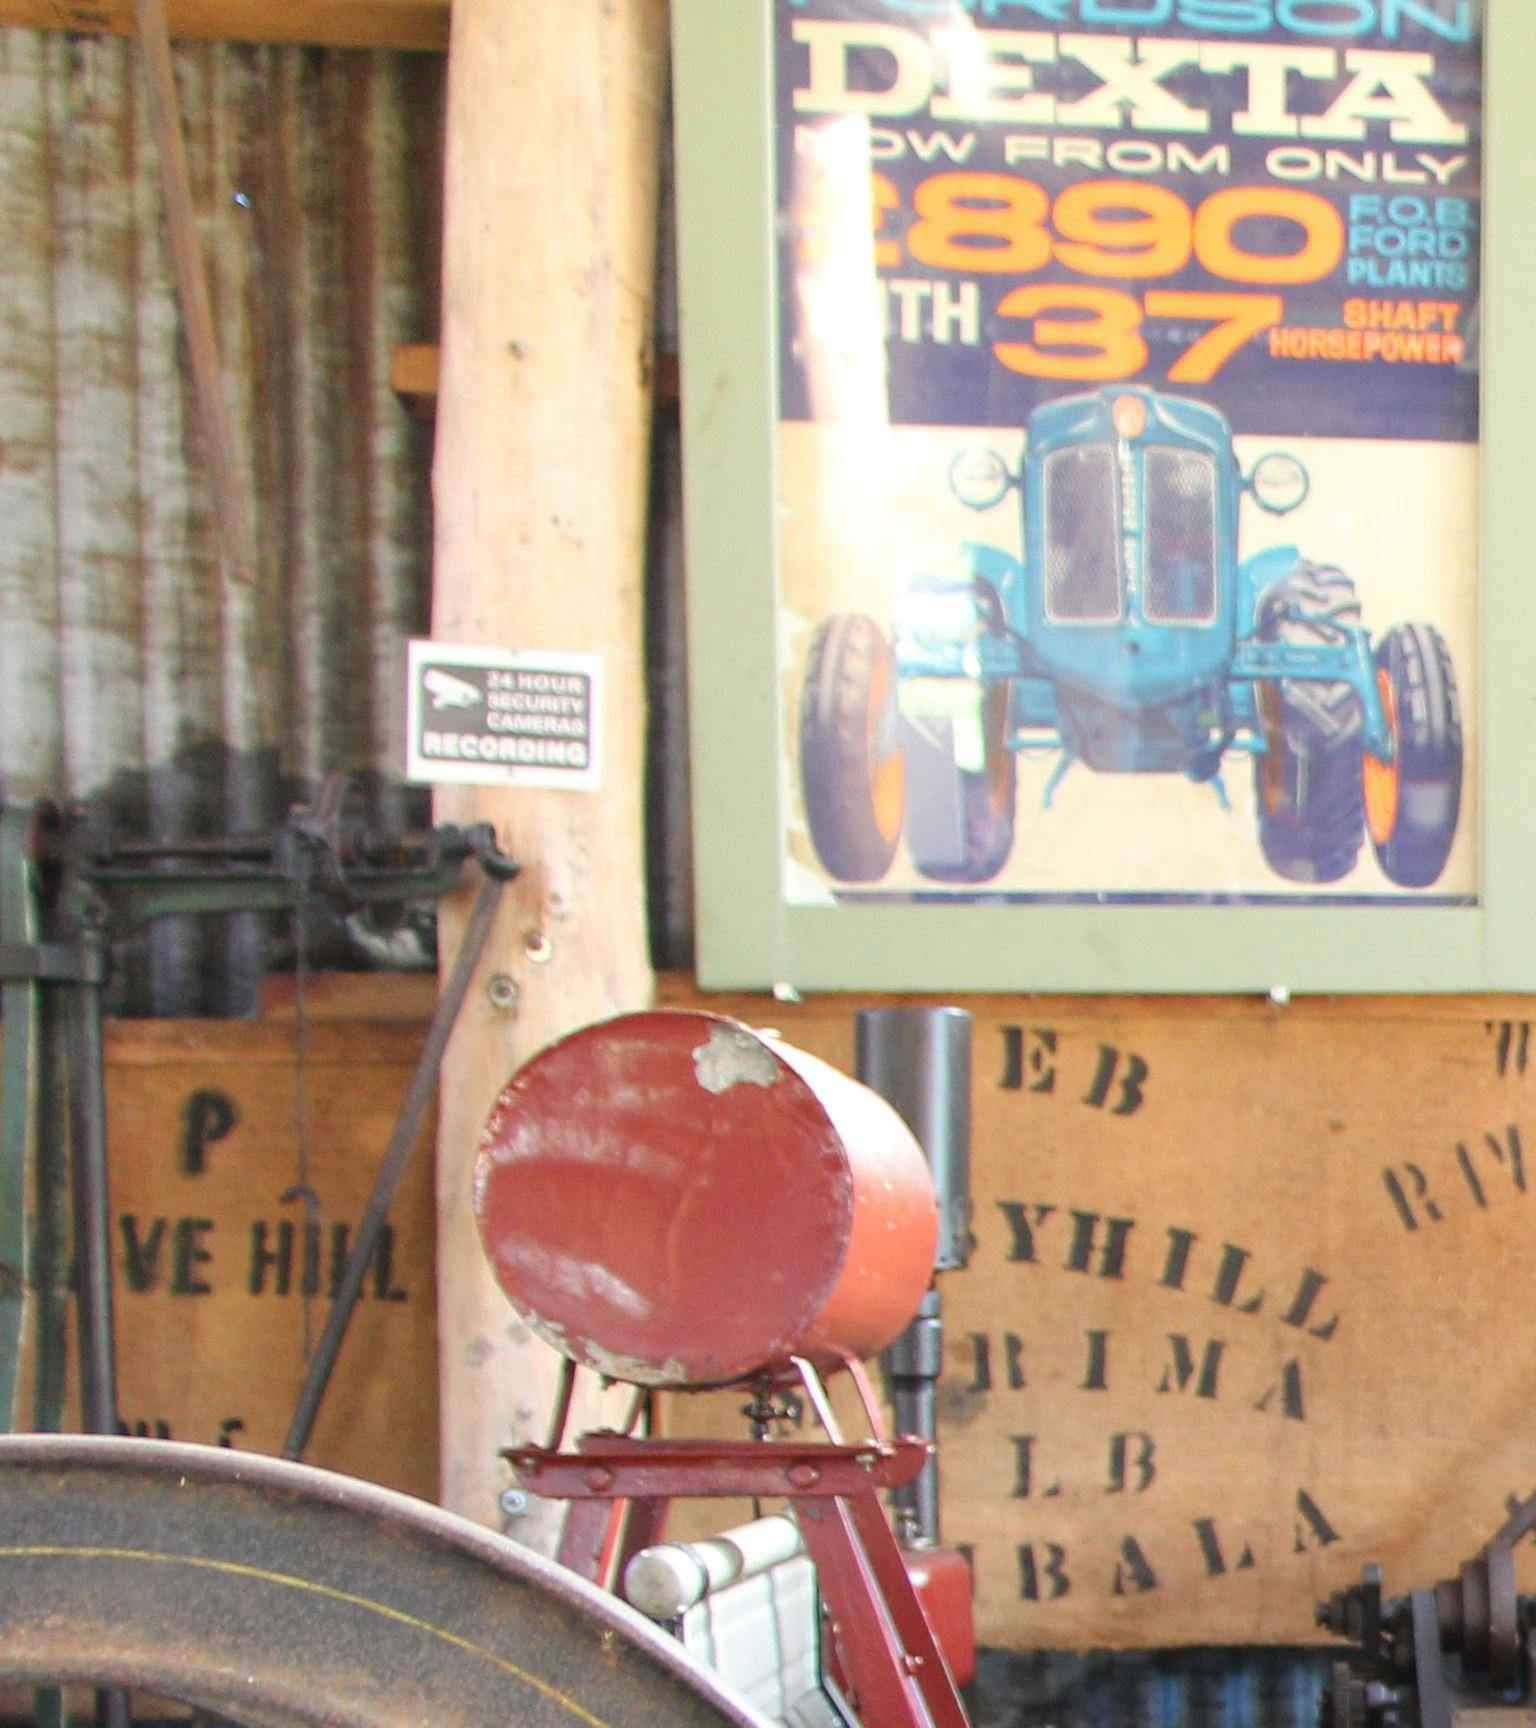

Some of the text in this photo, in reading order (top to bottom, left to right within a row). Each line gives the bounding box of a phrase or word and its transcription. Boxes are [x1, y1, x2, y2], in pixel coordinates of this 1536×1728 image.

[792, 19, 1468, 144] DEXTA
[795, 125, 1469, 185] OW FROM ONLY
[1349, 224, 1470, 260] FORD
[1347, 256, 1467, 289] PLANTS
[992, 283, 1284, 382] 37
[1343, 297, 1462, 333] SHAFT
[1267, 326, 1466, 364] HORSEPOWER
[486, 669, 584, 696] 24 HOUR
[486, 690, 584, 716] SECURITY
[486, 710, 588, 738] CAMERAS
[422, 731, 588, 768] RECORDING
[180, 1089, 237, 1177] P
[956, 1485, 1342, 1602] BALA
